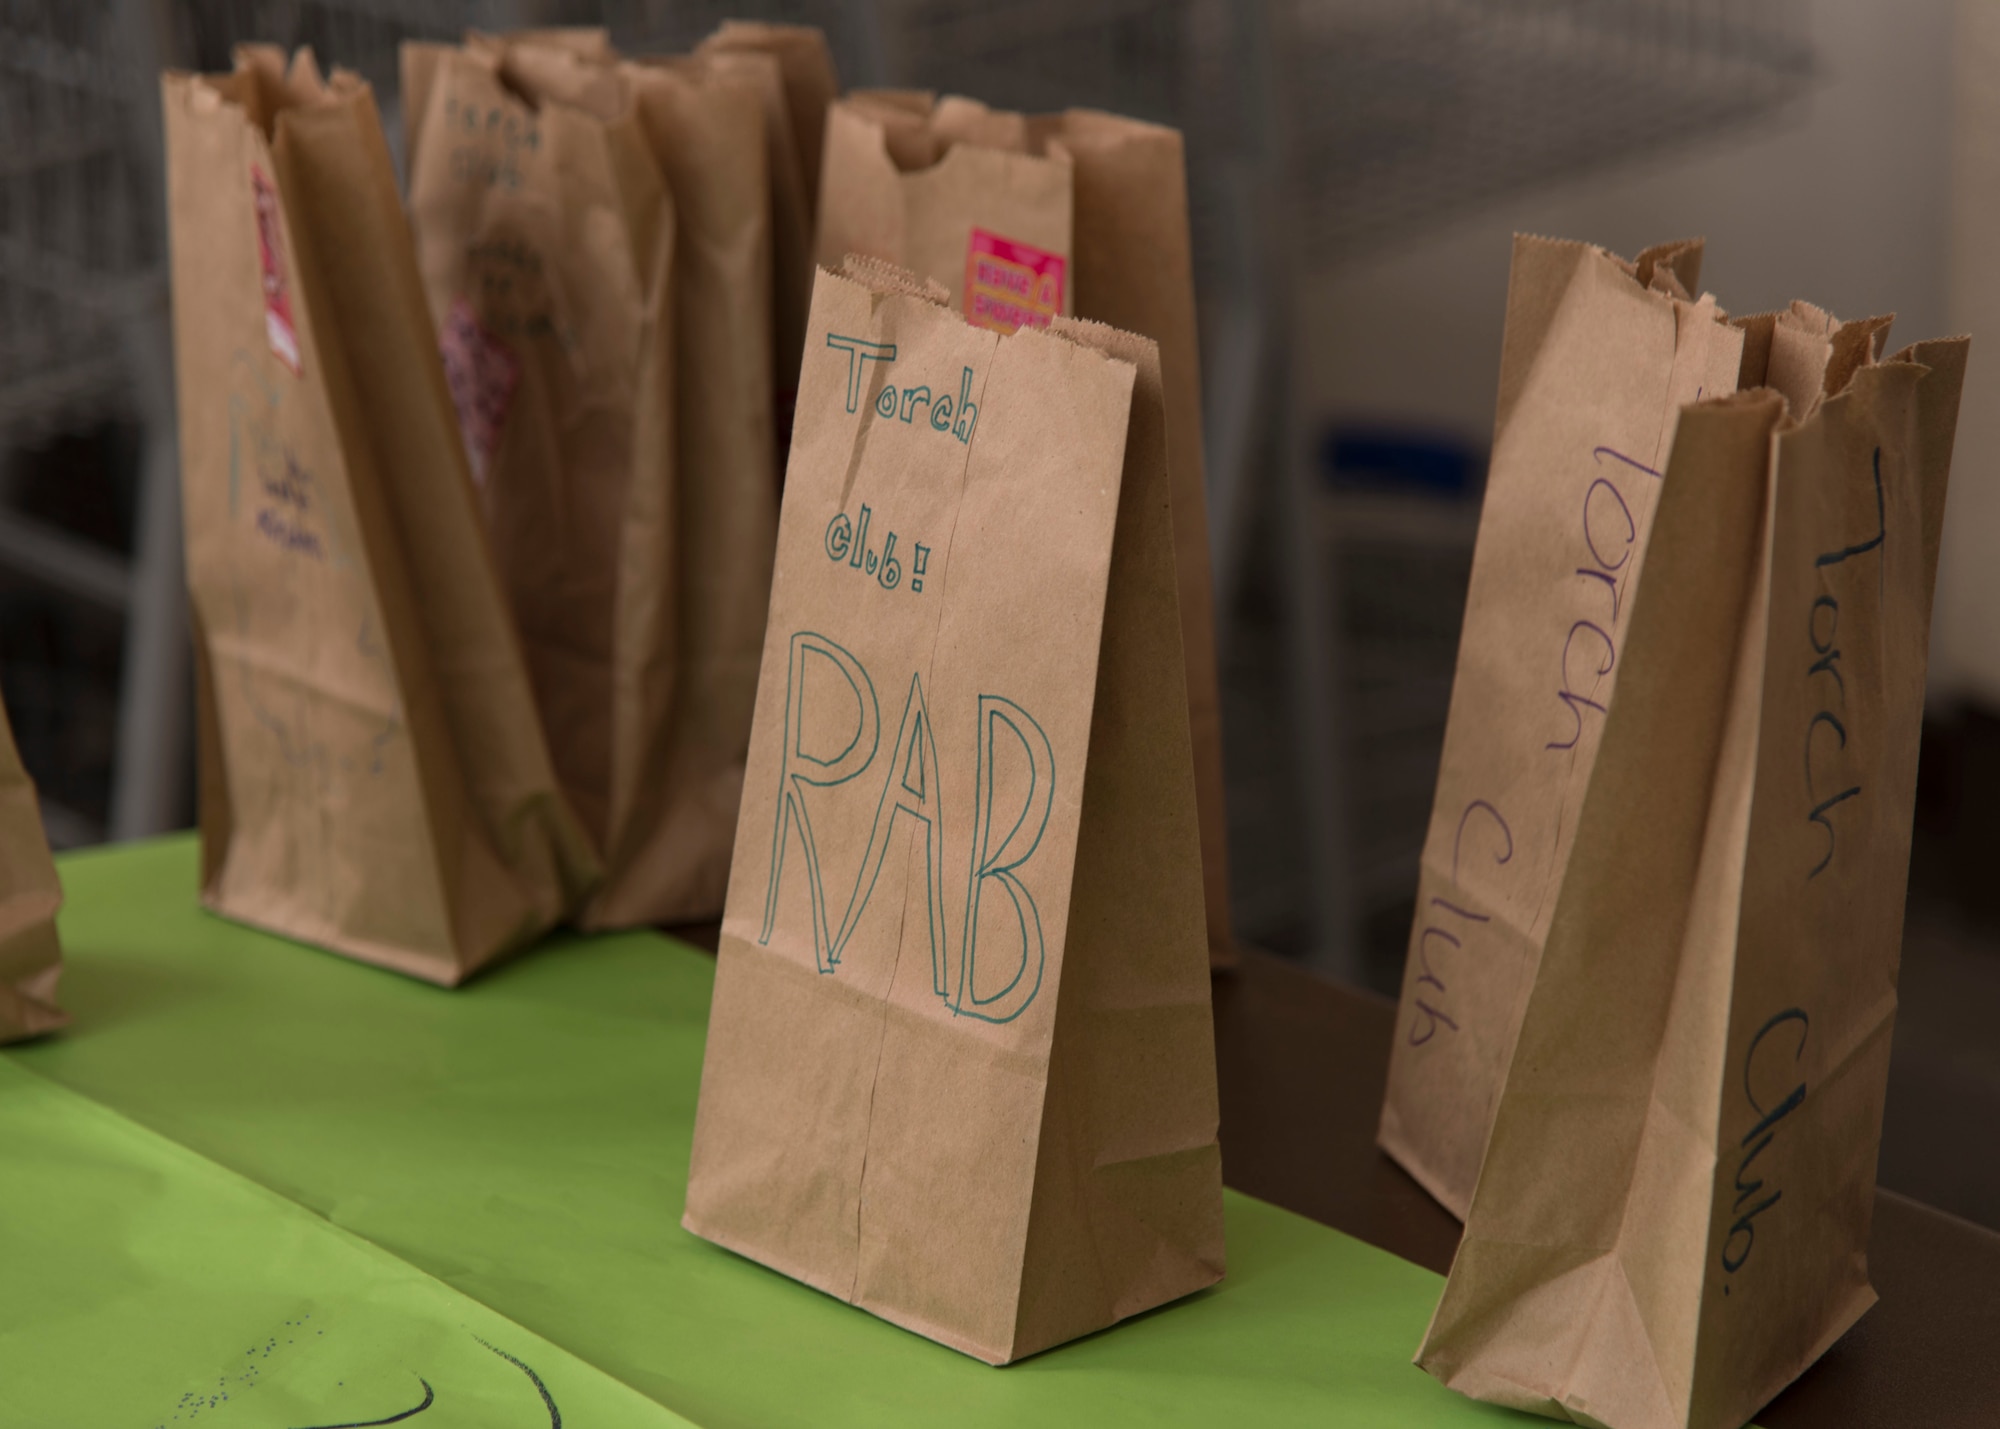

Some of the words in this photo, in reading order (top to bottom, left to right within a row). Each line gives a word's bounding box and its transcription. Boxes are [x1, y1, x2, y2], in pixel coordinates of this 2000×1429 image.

[827, 333, 977, 445] Torch
[1806, 446, 1886, 882] Torch
[758, 631, 1056, 1024] RAB
[1408, 798, 1513, 1046] Club
